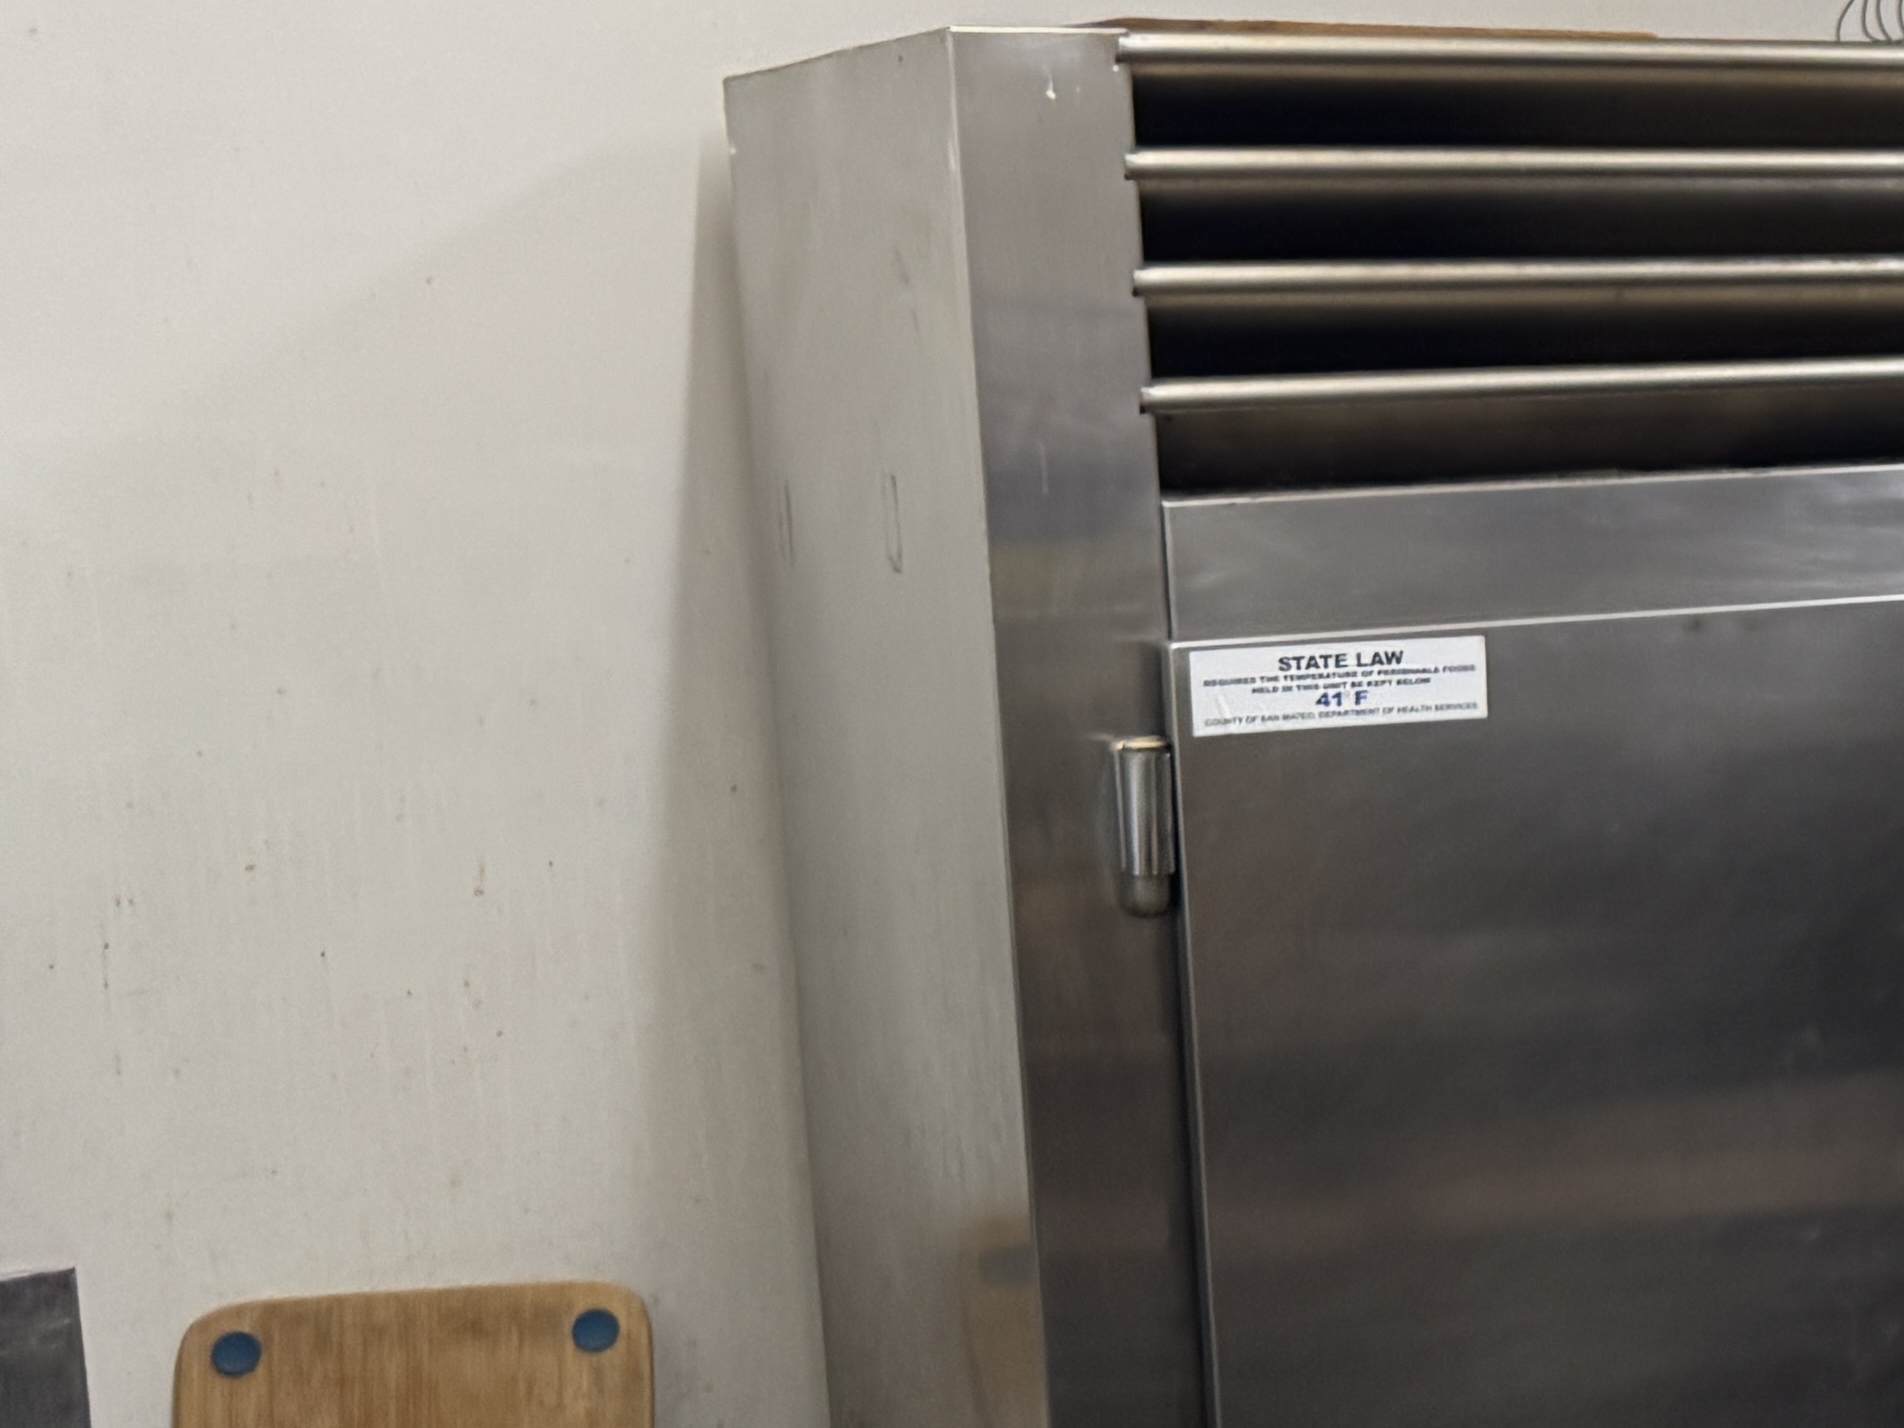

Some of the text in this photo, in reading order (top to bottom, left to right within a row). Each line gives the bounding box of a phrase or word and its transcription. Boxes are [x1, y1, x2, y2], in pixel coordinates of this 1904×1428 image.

[1278, 650, 1403, 671] STATE LAW
[1284, 670, 1358, 682] TEMPERATURE
[1354, 689, 1368, 706] F
